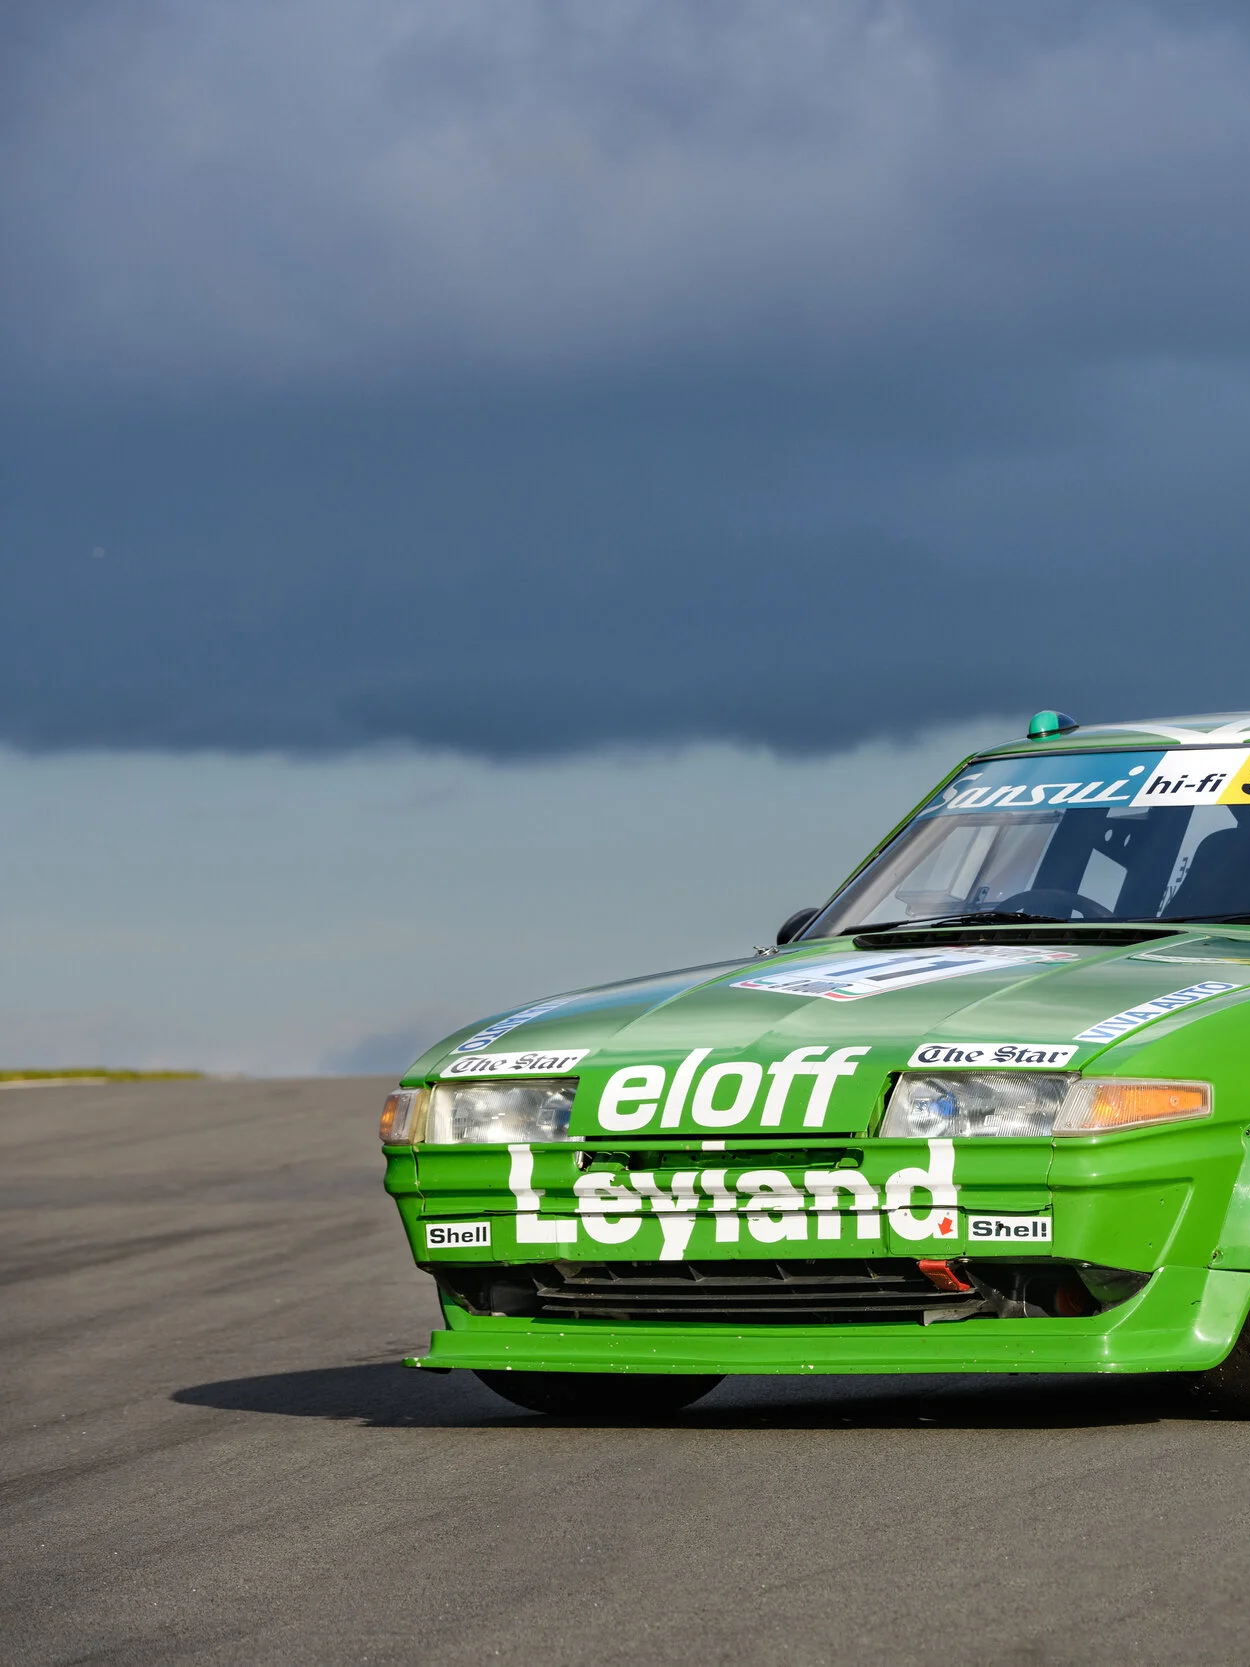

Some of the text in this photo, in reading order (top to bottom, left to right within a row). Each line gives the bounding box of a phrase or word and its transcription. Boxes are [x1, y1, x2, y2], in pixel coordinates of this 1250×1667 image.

[922, 765, 1145, 814] Sansui
[1146, 773, 1227, 796] hi-fi
[1079, 982, 1234, 1039] VIVA AUTO
[451, 1053, 578, 1074] The Star
[918, 1045, 1069, 1064] The Star
[598, 1046, 872, 1131] eloff
[508, 1139, 959, 1261] Leyland
[430, 1226, 487, 1244] Shell
